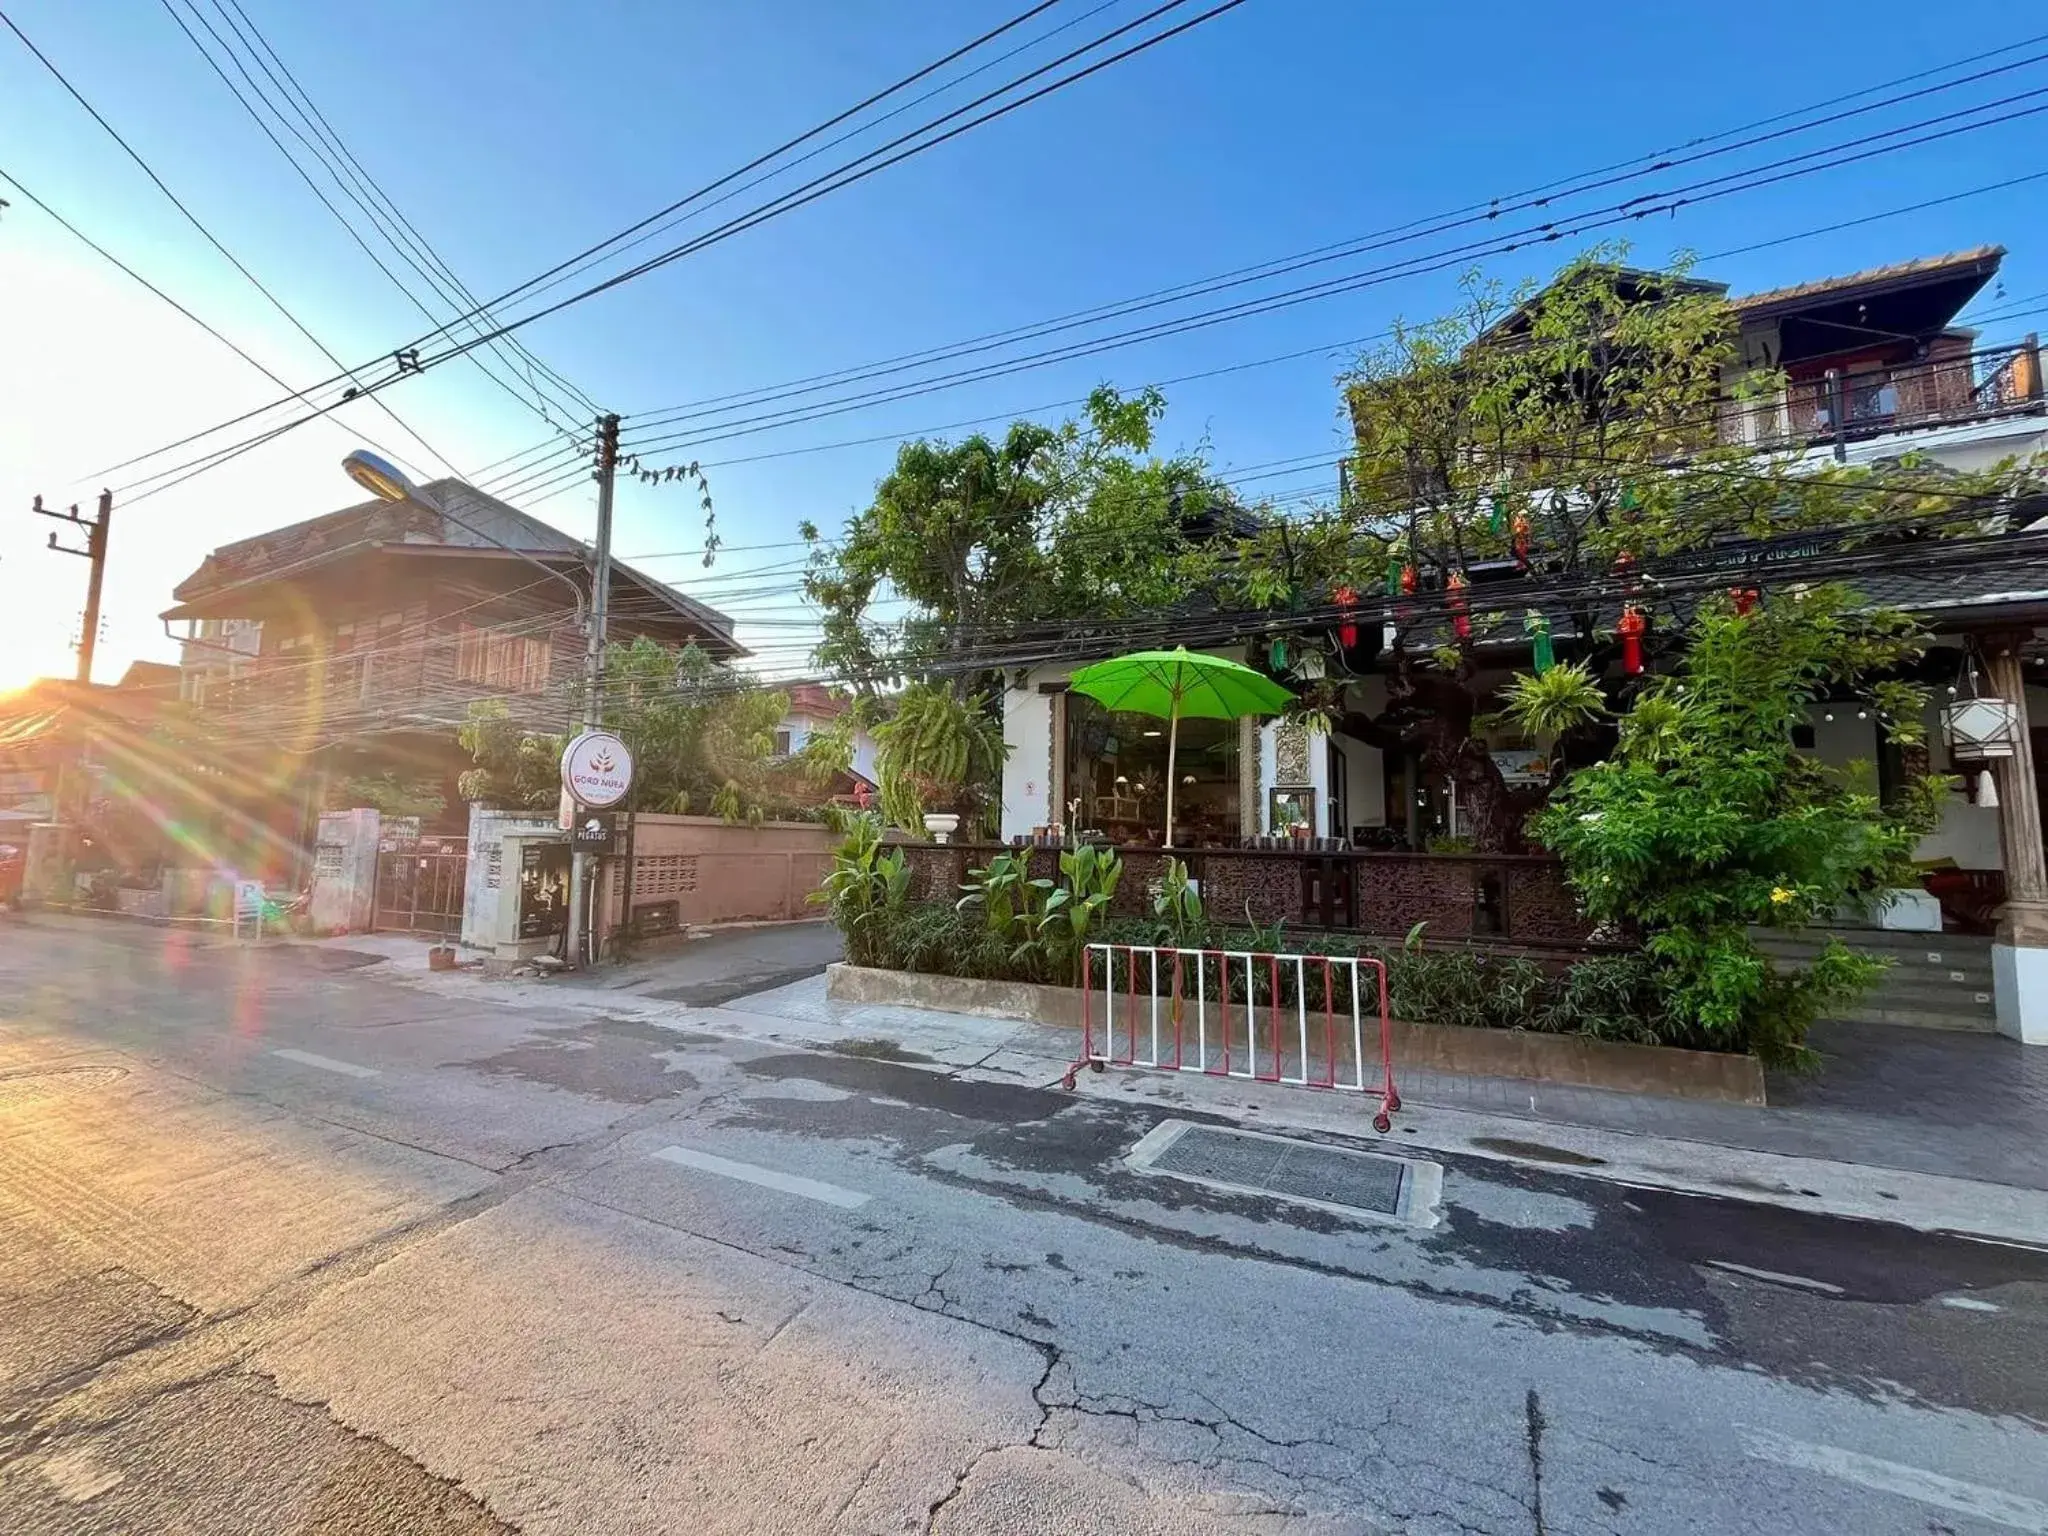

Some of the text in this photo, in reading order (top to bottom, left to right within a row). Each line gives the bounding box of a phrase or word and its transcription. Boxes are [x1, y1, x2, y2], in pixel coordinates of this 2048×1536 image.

[574, 775, 624, 789] GORD NUEA
[577, 831, 607, 841] PEGASUS
